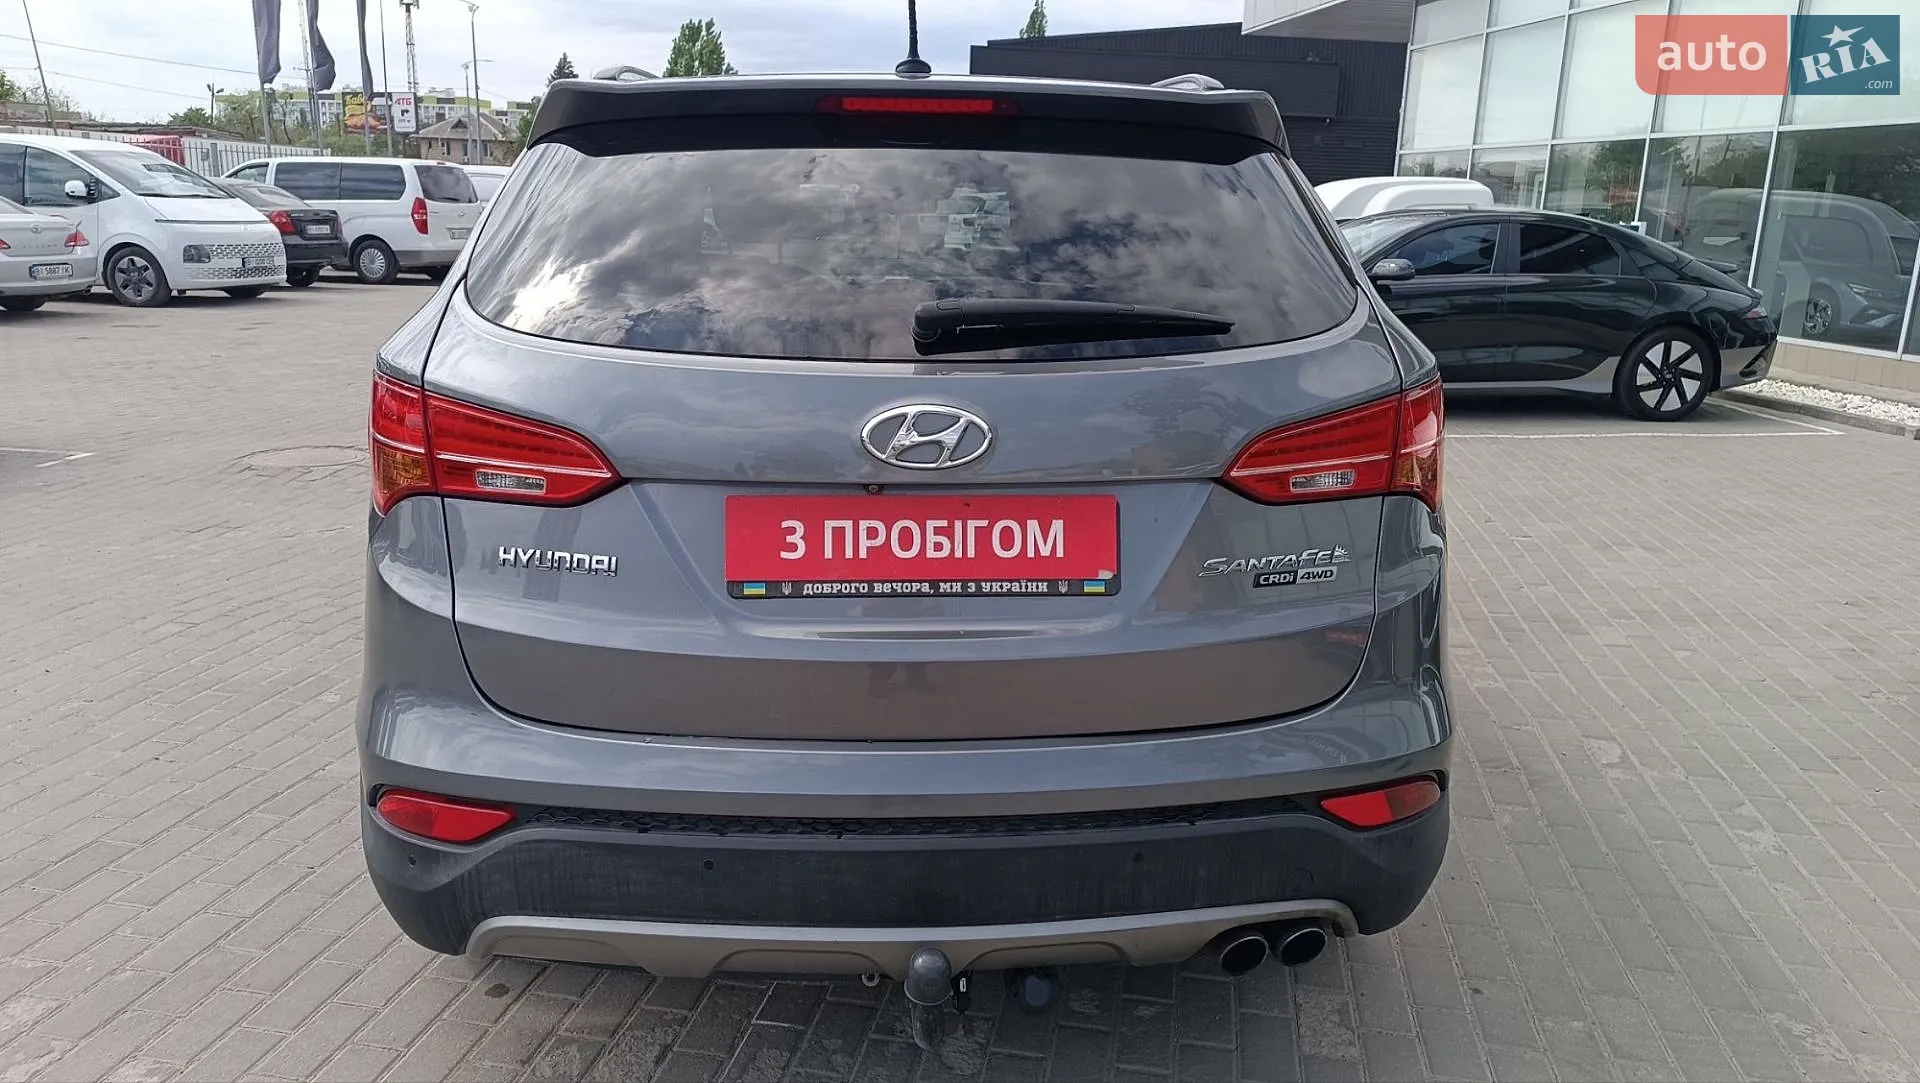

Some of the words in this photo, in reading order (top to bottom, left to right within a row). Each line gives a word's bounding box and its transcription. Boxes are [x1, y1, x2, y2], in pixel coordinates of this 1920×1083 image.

[780, 519, 806, 560] З
[824, 519, 1065, 560] ПРОБІГОМ
[498, 546, 618, 577] HYUNDAI
[939, 581, 962, 593] МИ
[1259, 573, 1294, 585] CRDi
[1300, 569, 1334, 580] 4WD
